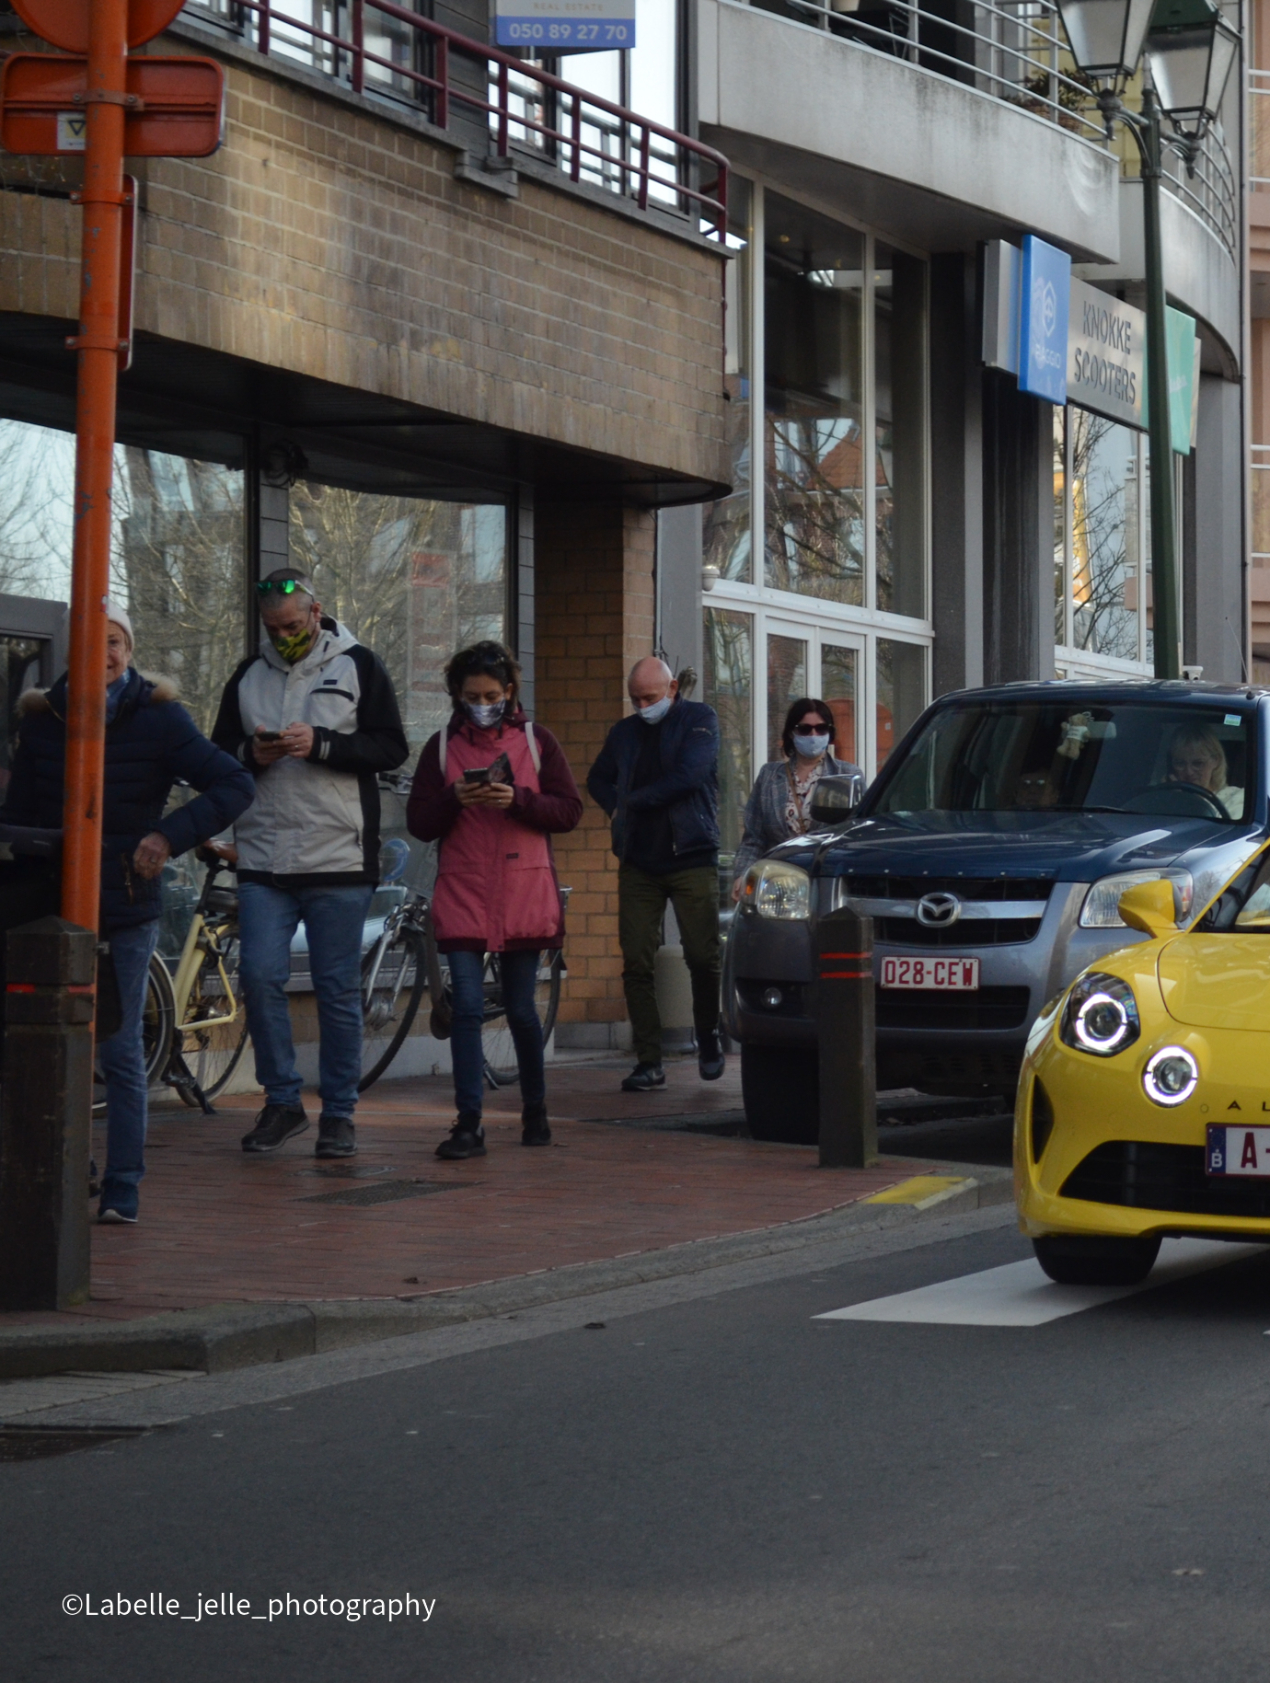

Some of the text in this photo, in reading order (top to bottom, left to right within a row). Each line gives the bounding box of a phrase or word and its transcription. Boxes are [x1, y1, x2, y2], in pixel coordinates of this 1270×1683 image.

[565, 3, 604, 11] ESTATE
[509, 23, 628, 40] 050 89 27 70
[1083, 301, 1132, 355] KNOKKE
[1074, 348, 1136, 405] SCOOTERS
[885, 960, 973, 987] 028-CEW
[1211, 1153, 1223, 1168] B
